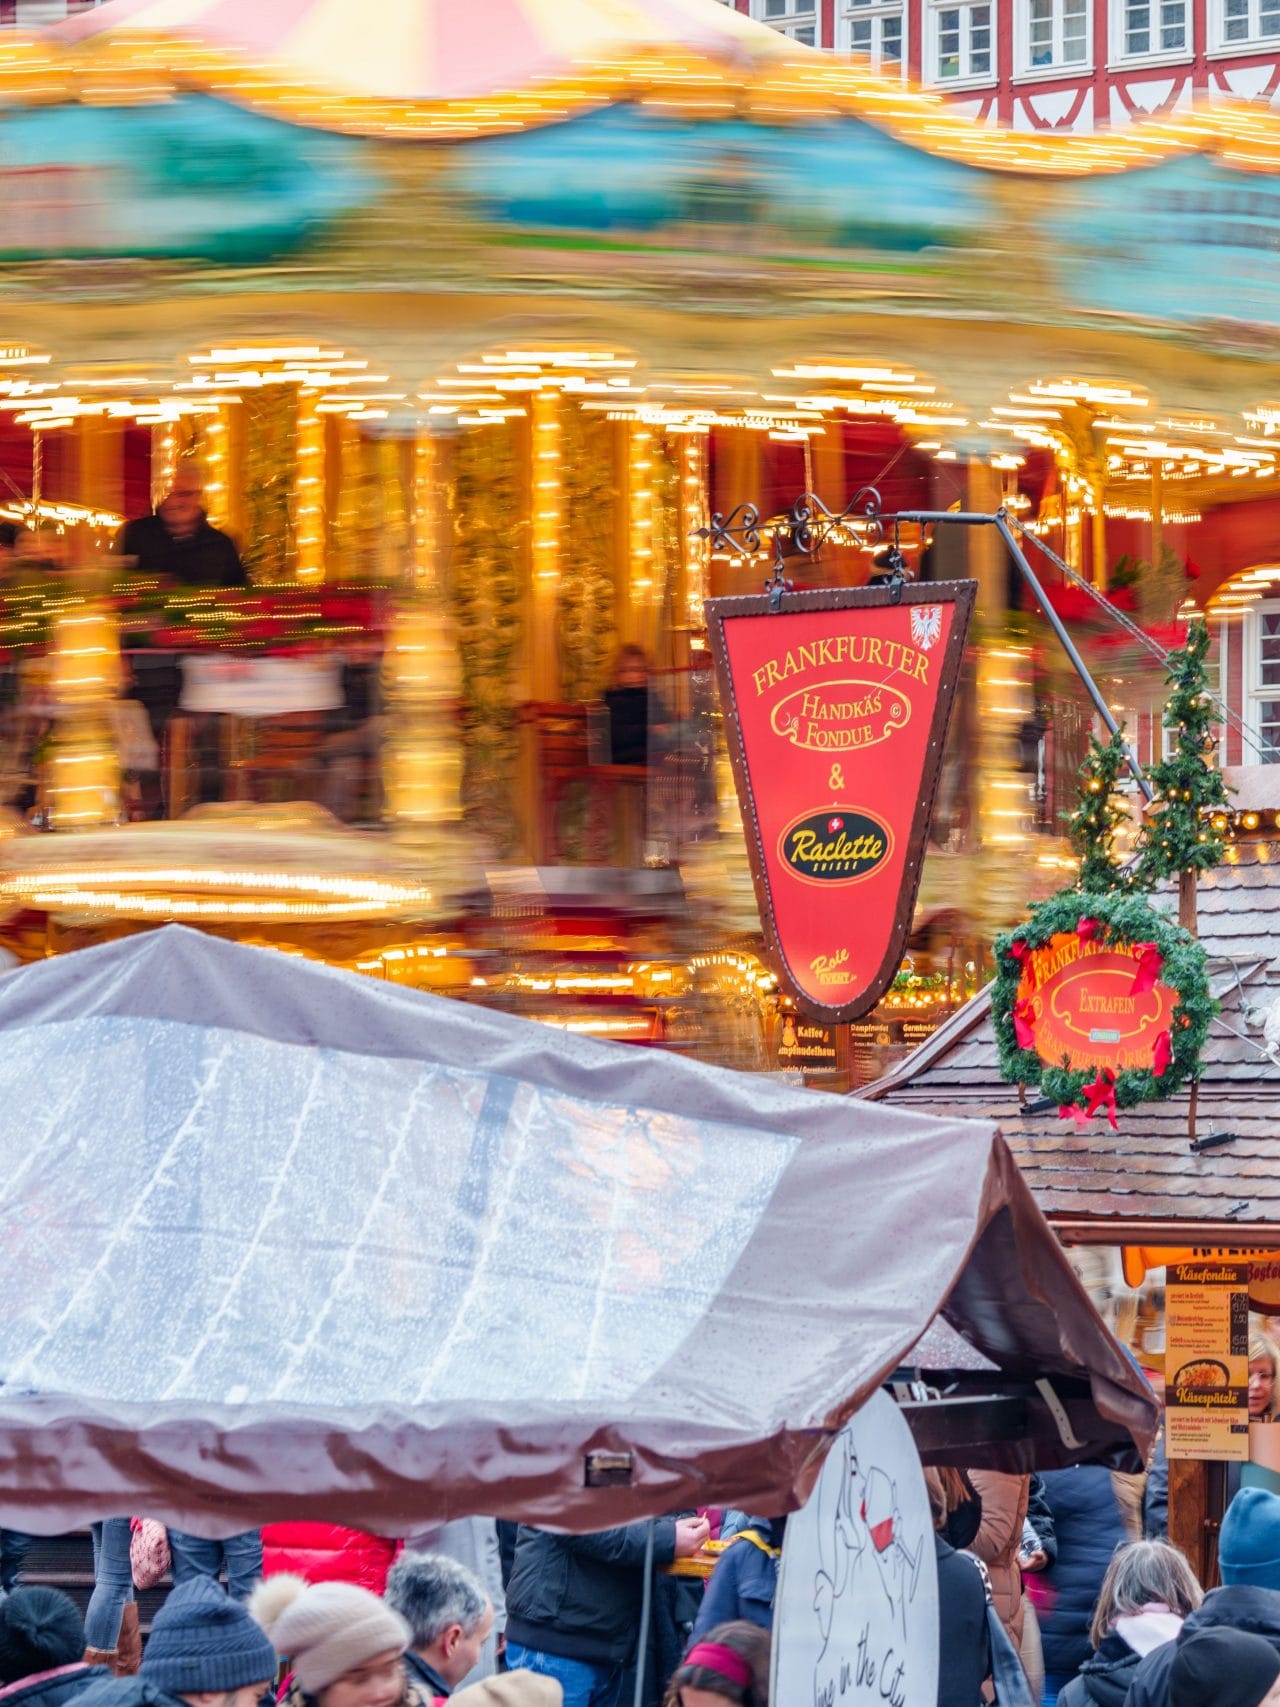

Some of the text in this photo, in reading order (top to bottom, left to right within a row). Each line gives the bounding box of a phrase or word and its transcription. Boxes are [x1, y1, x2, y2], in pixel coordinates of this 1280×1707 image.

[752, 635, 929, 696] FRANKFURTER
[805, 721, 874, 747] FONDUE
[827, 763, 846, 790] &
[791, 830, 882, 862] Raclette
[1079, 987, 1135, 1014] EXTRAFEIN
[797, 1026, 823, 1038] Kaffee
[1176, 1264, 1237, 1284] Käsefondue
[1176, 1388, 1238, 1408] Käsespätzle
